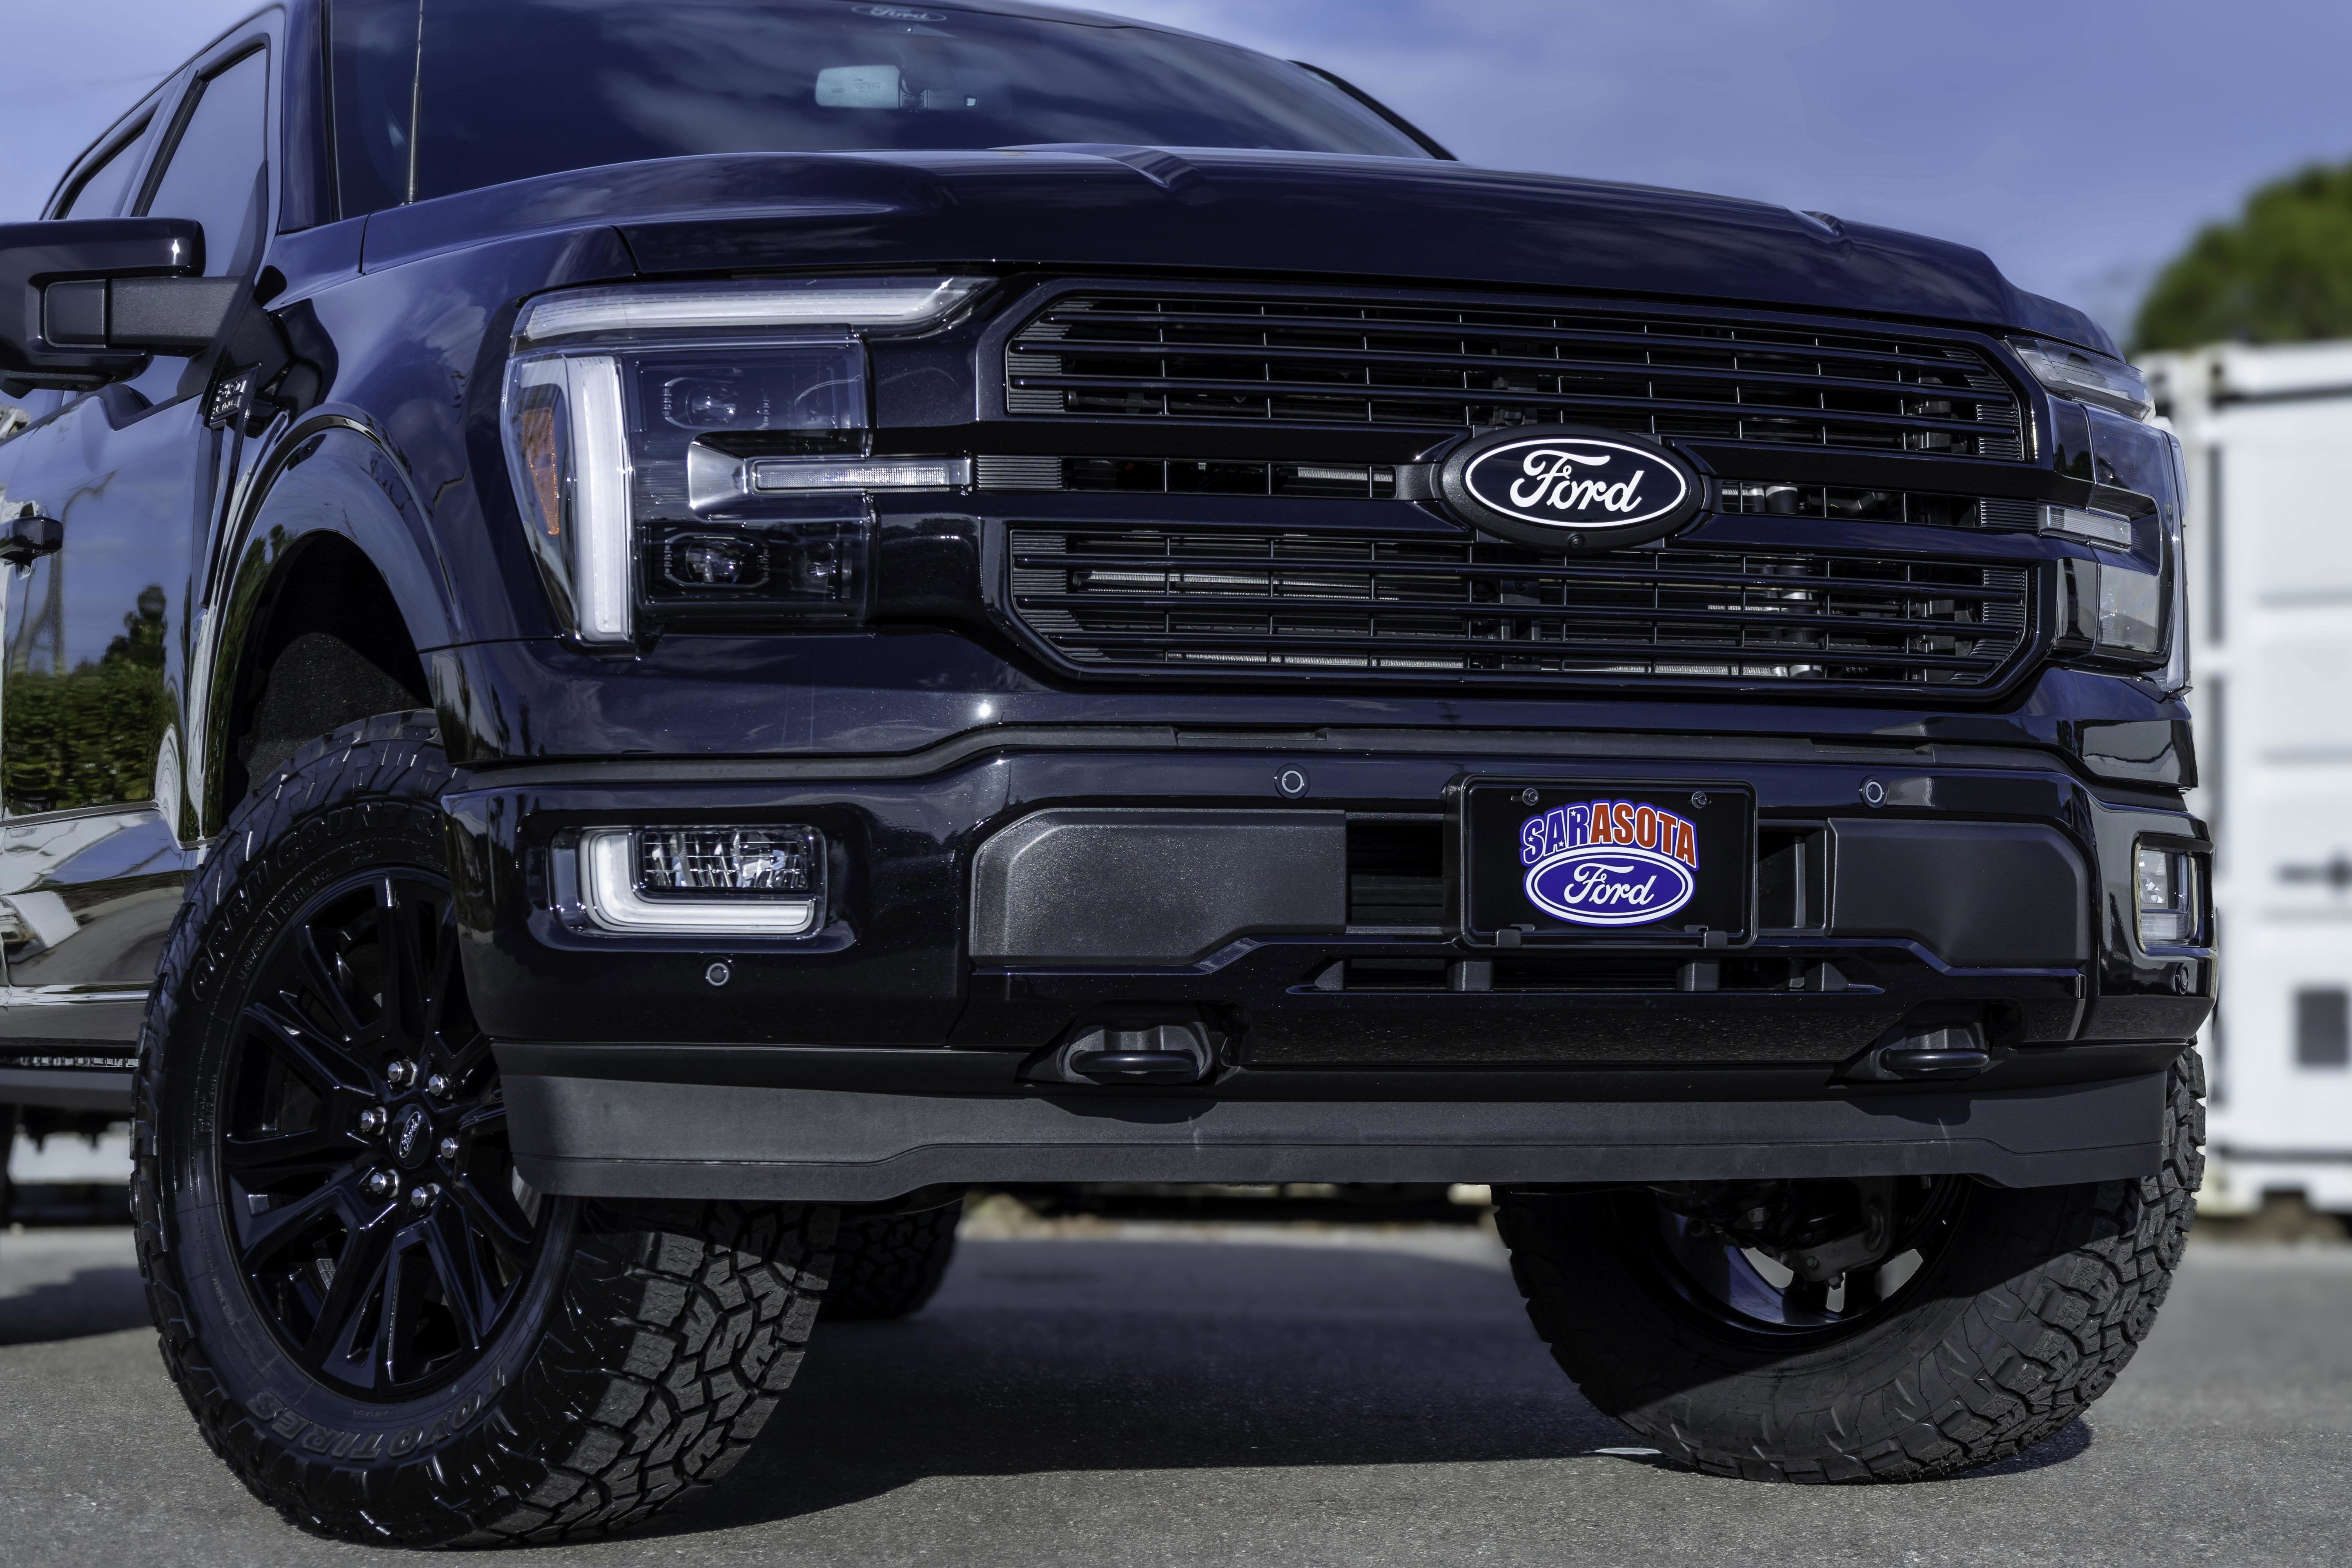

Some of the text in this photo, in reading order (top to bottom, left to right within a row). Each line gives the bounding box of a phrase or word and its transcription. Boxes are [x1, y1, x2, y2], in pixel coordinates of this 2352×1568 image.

[870, 6, 930, 20] Ford
[1510, 450, 1644, 512] Ford
[277, 802, 441, 869] COUNTR
[1522, 801, 1697, 868] SARASOTA
[1564, 863, 1656, 905] Ford
[402, 1119, 419, 1152] Ford
[246, 1365, 506, 1460] TOYO TIRES
